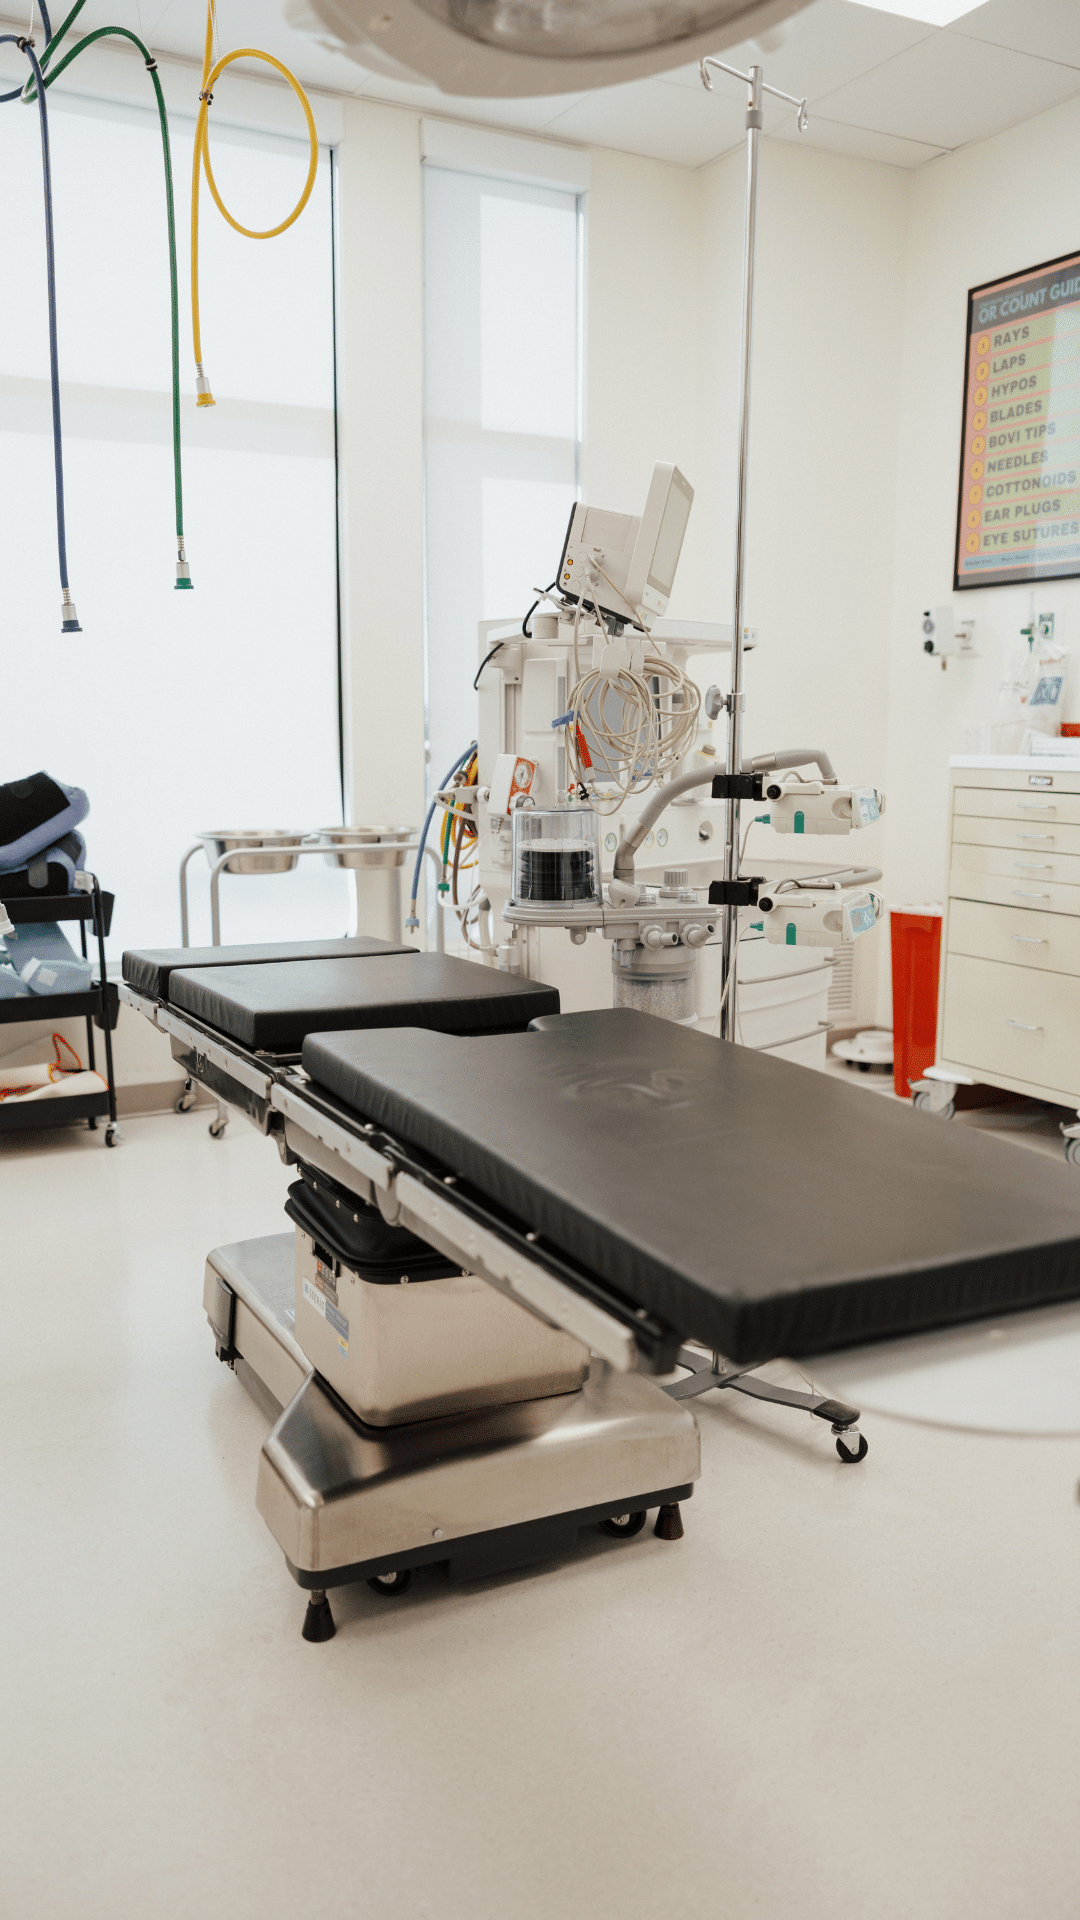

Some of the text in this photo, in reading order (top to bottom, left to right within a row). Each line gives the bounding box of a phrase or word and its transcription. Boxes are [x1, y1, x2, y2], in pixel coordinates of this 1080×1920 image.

[978, 305, 997, 324] OR
[999, 287, 1047, 317] COUNT
[994, 326, 1030, 347] RAYS
[993, 353, 1026, 374] LAPS
[992, 375, 1037, 398] HYPOS
[990, 400, 1042, 423] BLADES
[989, 422, 1056, 448] BOVI TIPS
[988, 449, 1048, 473] NEEDLES
[987, 470, 1077, 498] COTTONOIDS
[985, 508, 1010, 522] EAR
[1015, 499, 1061, 517] PLUGS
[984, 521, 1079, 546] EYE SUTURES
[309, 1288, 325, 1311] STERIS
